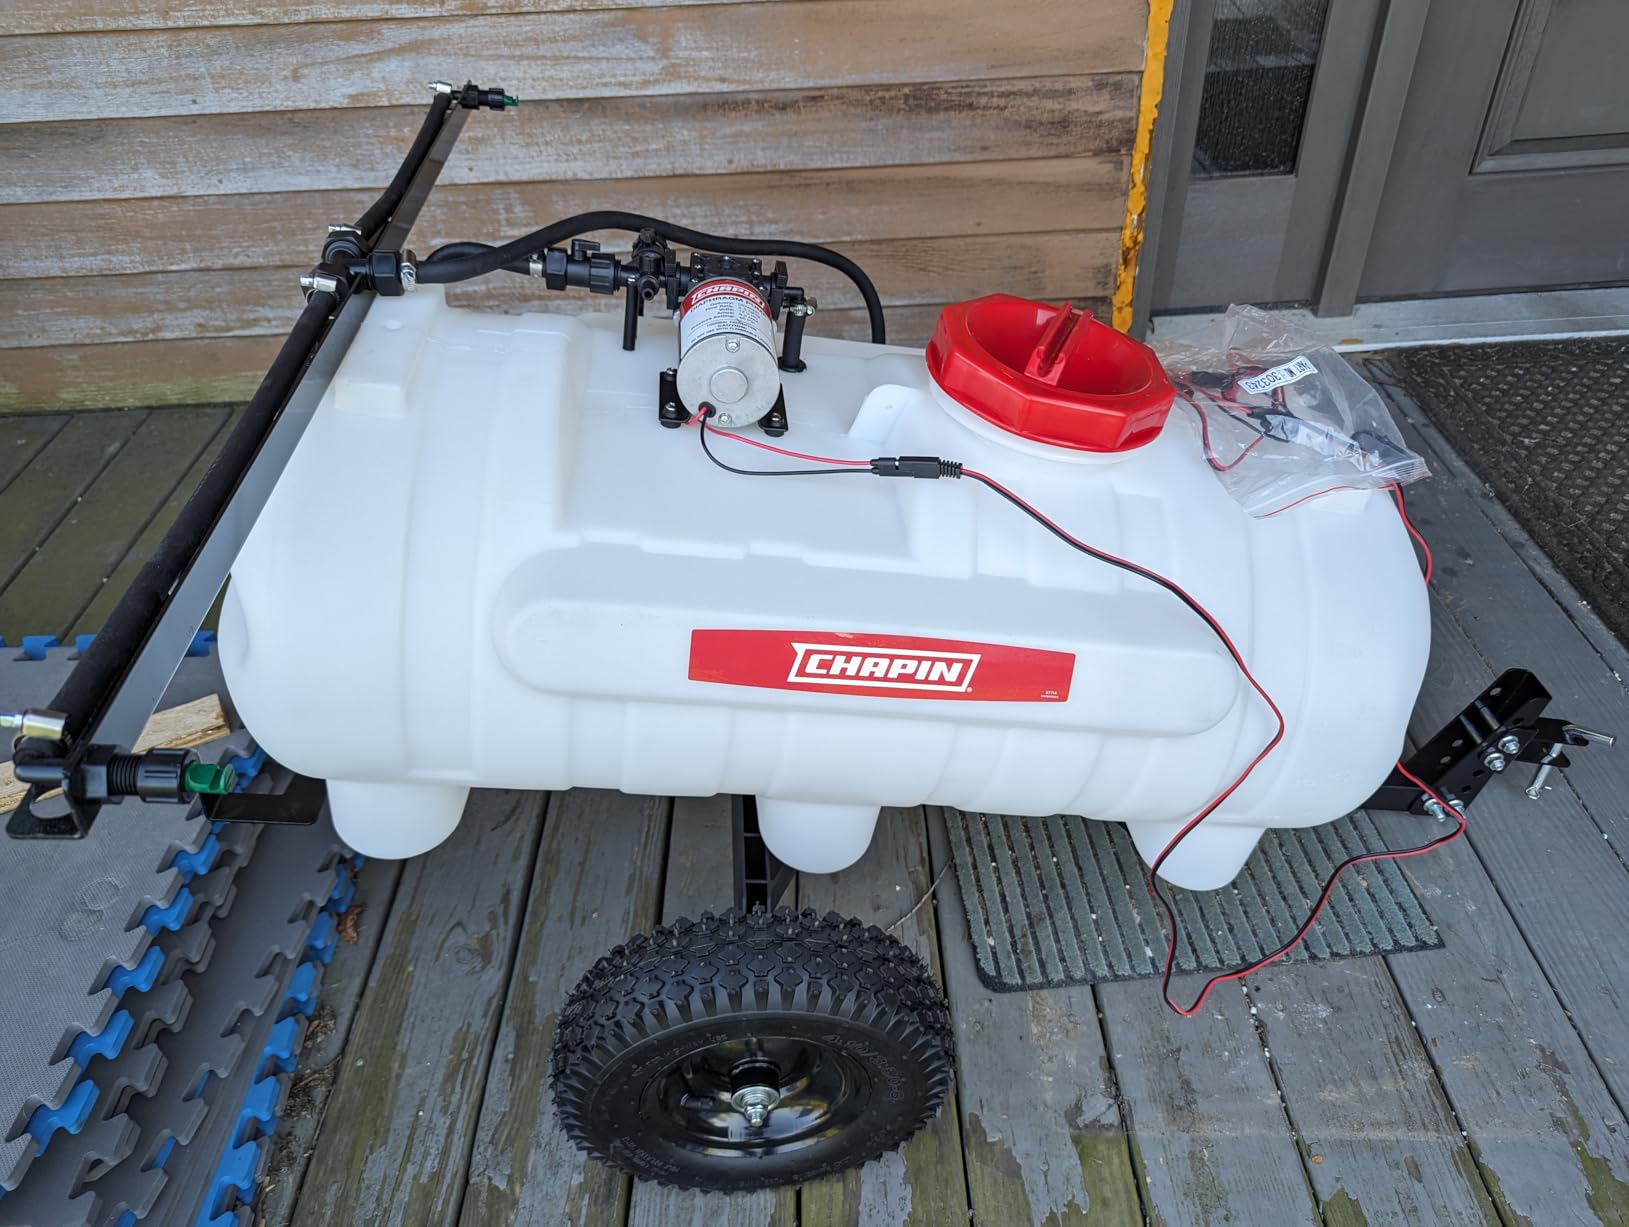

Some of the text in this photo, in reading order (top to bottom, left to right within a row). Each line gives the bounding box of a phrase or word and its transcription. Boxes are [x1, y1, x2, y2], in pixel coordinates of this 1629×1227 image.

[690, 296, 744, 312] DIAPHRAGM
[696, 286, 761, 304] CHAPIN
[804, 653, 964, 682] CHAPIN
